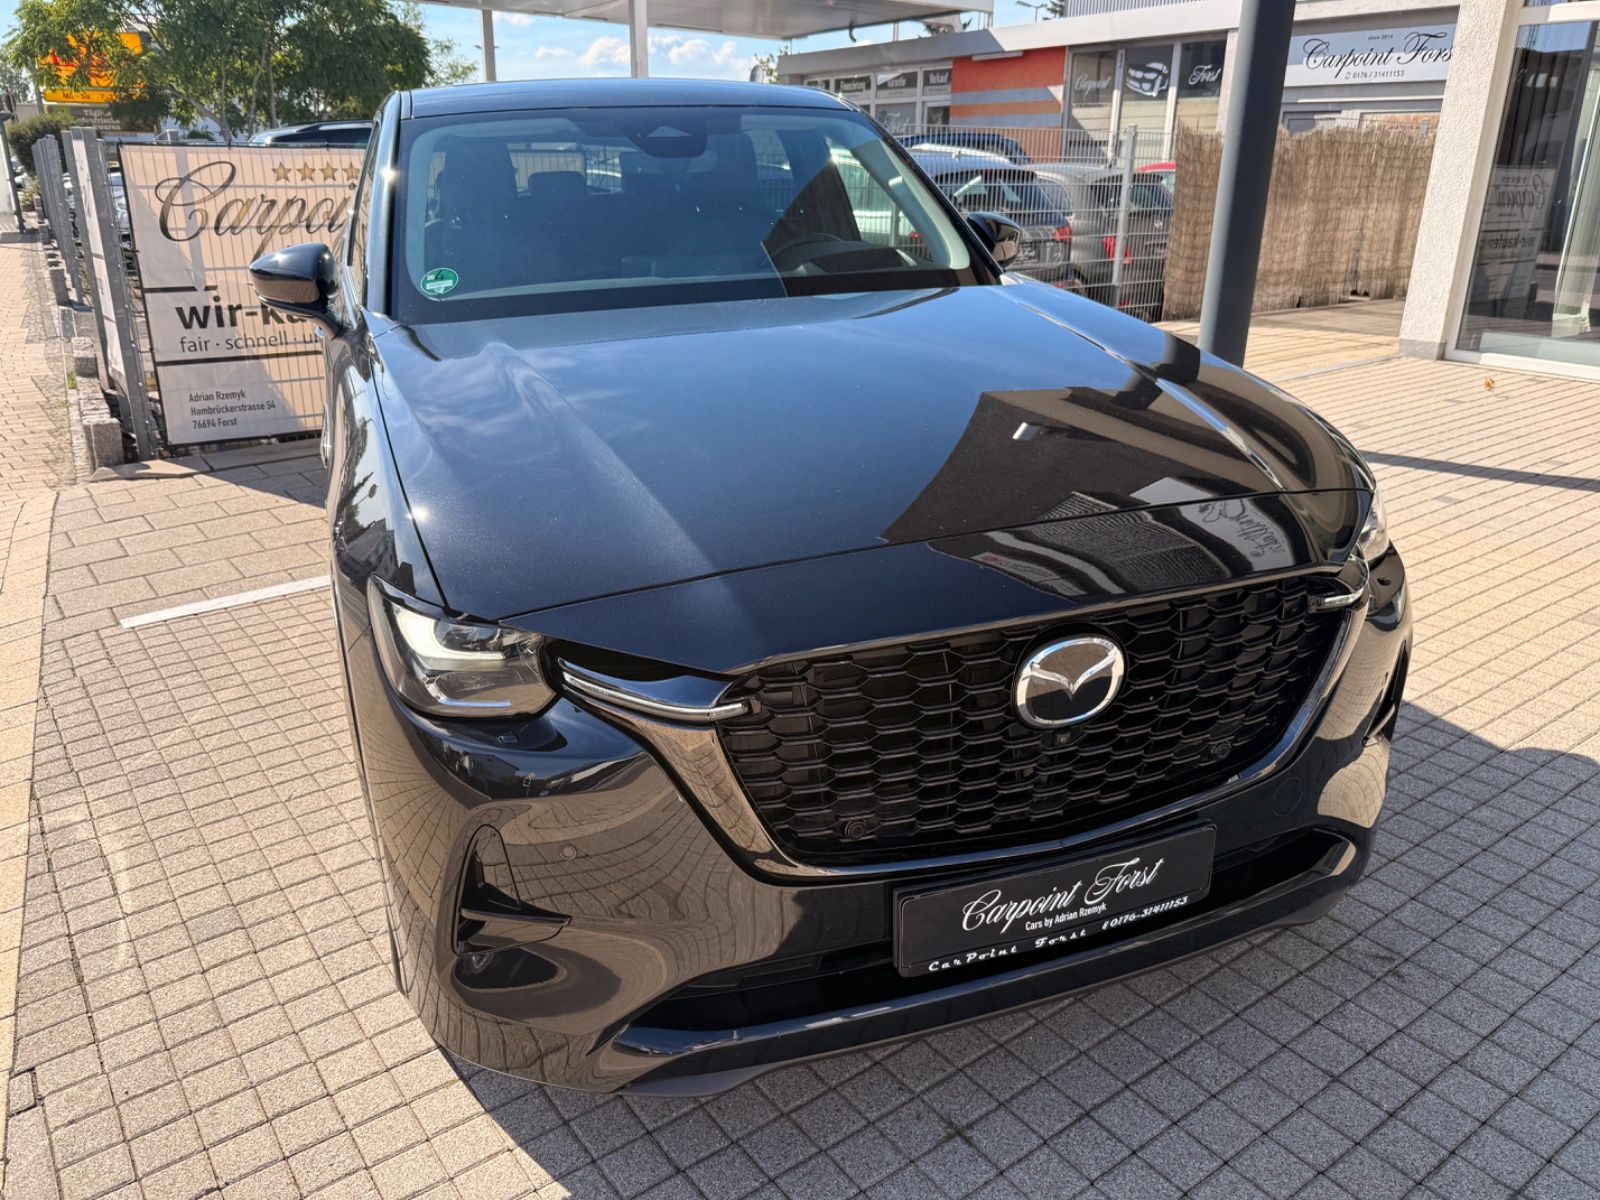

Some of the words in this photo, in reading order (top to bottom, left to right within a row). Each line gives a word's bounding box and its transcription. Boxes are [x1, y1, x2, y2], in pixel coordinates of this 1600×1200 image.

[1303, 38, 1394, 79] Carpoint
[1397, 32, 1453, 65] Fors
[1188, 64, 1222, 86] Forst
[1352, 71, 1368, 79] 0176
[1374, 70, 1405, 78] 31411153
[155, 160, 356, 262] Carpoi
[180, 335, 211, 353] fair
[225, 330, 288, 350] schnell
[189, 392, 215, 402] Adrian
[216, 389, 246, 401] Rzemyk
[191, 402, 265, 416] Hambrückerstrasse
[266, 400, 276, 410] 54
[192, 418, 216, 429] 76694
[218, 417, 238, 427] Forst
[961, 879, 1083, 935] Carpoint
[1084, 857, 1166, 905] Forst
[1025, 919, 1043, 931] Cars
[1044, 916, 1054, 928] by
[1054, 911, 1078, 924] Adrian
[1079, 902, 1106, 917] Rzemyk
[1034, 928, 1087, 949] Forst
